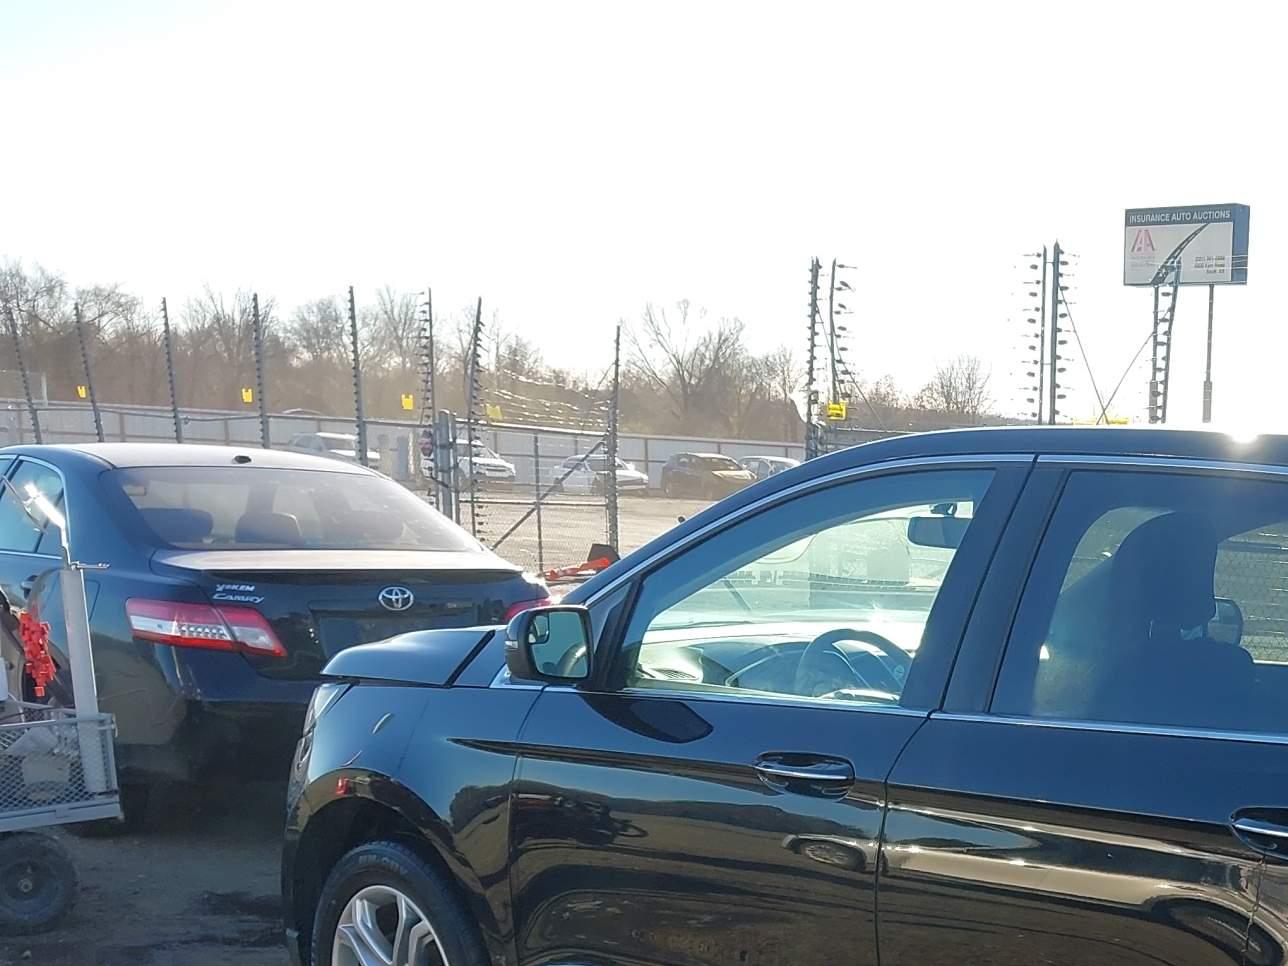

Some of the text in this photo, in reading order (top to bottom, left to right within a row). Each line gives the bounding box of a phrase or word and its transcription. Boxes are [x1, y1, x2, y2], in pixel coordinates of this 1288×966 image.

[1129, 210, 1231, 224] INSURANCE AUTO AUCTIONS
